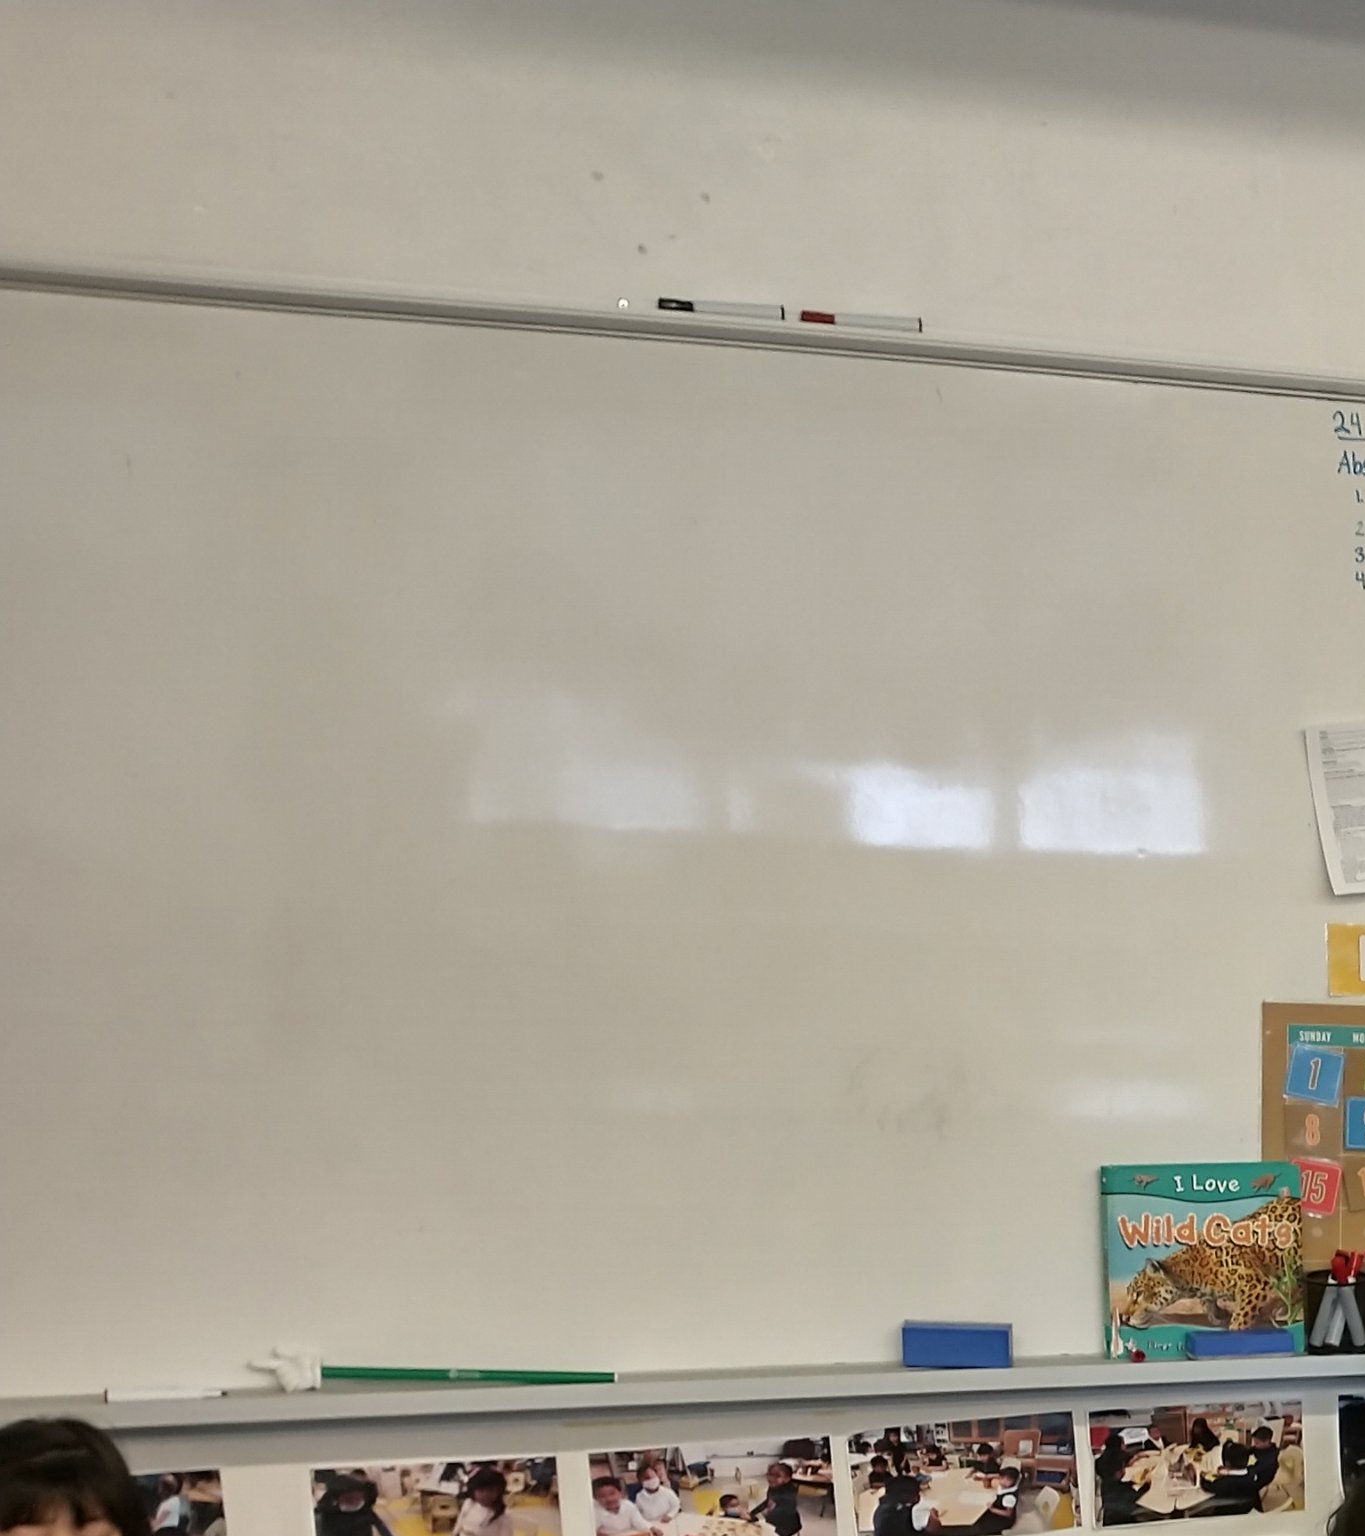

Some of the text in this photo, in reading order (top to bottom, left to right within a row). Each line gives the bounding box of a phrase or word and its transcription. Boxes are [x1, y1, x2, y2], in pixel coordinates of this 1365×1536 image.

[1333, 411, 1363, 437] 24
[1299, 1030, 1332, 1043] SUNDAY
[1308, 1057, 1321, 1090] 1
[1305, 1114, 1320, 1146] 8
[1173, 1174, 1240, 1193] I Love
[1301, 1169, 1327, 1204] 15
[1118, 1212, 1294, 1249] Wild Cats
